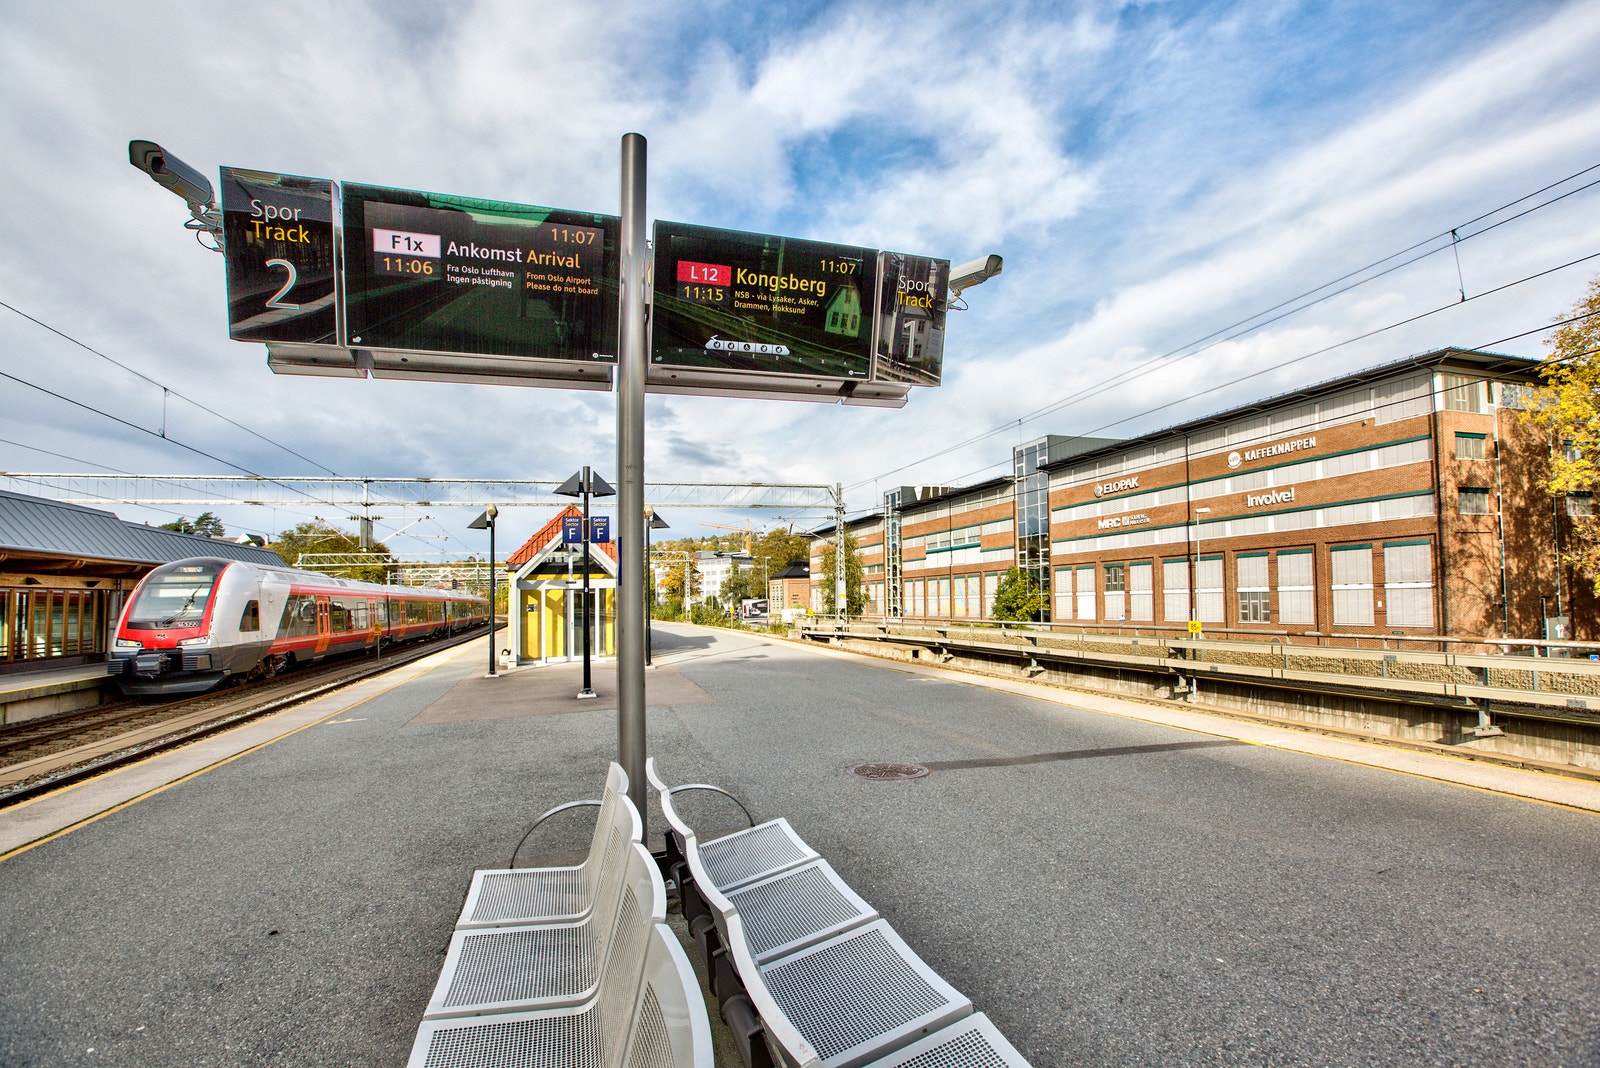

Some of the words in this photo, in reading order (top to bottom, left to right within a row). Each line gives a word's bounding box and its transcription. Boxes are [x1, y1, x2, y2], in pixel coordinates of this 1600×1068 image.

[250, 199, 302, 222] Spor
[250, 220, 311, 244] Track
[551, 227, 597, 246] 11:07
[446, 240, 523, 263] Ankomst
[526, 249, 581, 269] Arrival
[383, 256, 433, 275] 11:06
[446, 264, 460, 273] Fra
[461, 265, 480, 275] Oslo
[481, 267, 515, 278] Lufthavn
[820, 259, 857, 275] 11:07
[265, 258, 301, 311] 2
[446, 273, 470, 284] Ingen
[471, 276, 513, 289] påstigning
[526, 271, 546, 281] From
[547, 273, 565, 283] Oslo
[565, 275, 592, 286] Airport
[736, 267, 827, 298] Kongsberg
[898, 275, 930, 294] Spor
[526, 281, 551, 291] Please
[552, 284, 563, 292] do
[564, 286, 577, 294] not
[577, 286, 599, 296] board
[684, 285, 724, 302] 11:15
[734, 290, 750, 299] NSB
[756, 292, 767, 301] via
[768, 293, 797, 305] Lysaker,
[797, 297, 820, 307] Asker,
[734, 300, 771, 312] Drammen,
[772, 304, 806, 314] Hokksund
[897, 290, 934, 309] Track
[904, 320, 915, 358] 1
[1244, 437, 1316, 461] KAFFEKNAPPEN
[1103, 477, 1139, 494] ELOPAK
[1247, 487, 1296, 508] Involve!
[1097, 517, 1121, 530] MRC
[569, 528, 575, 539] F
[597, 528, 603, 539] F
